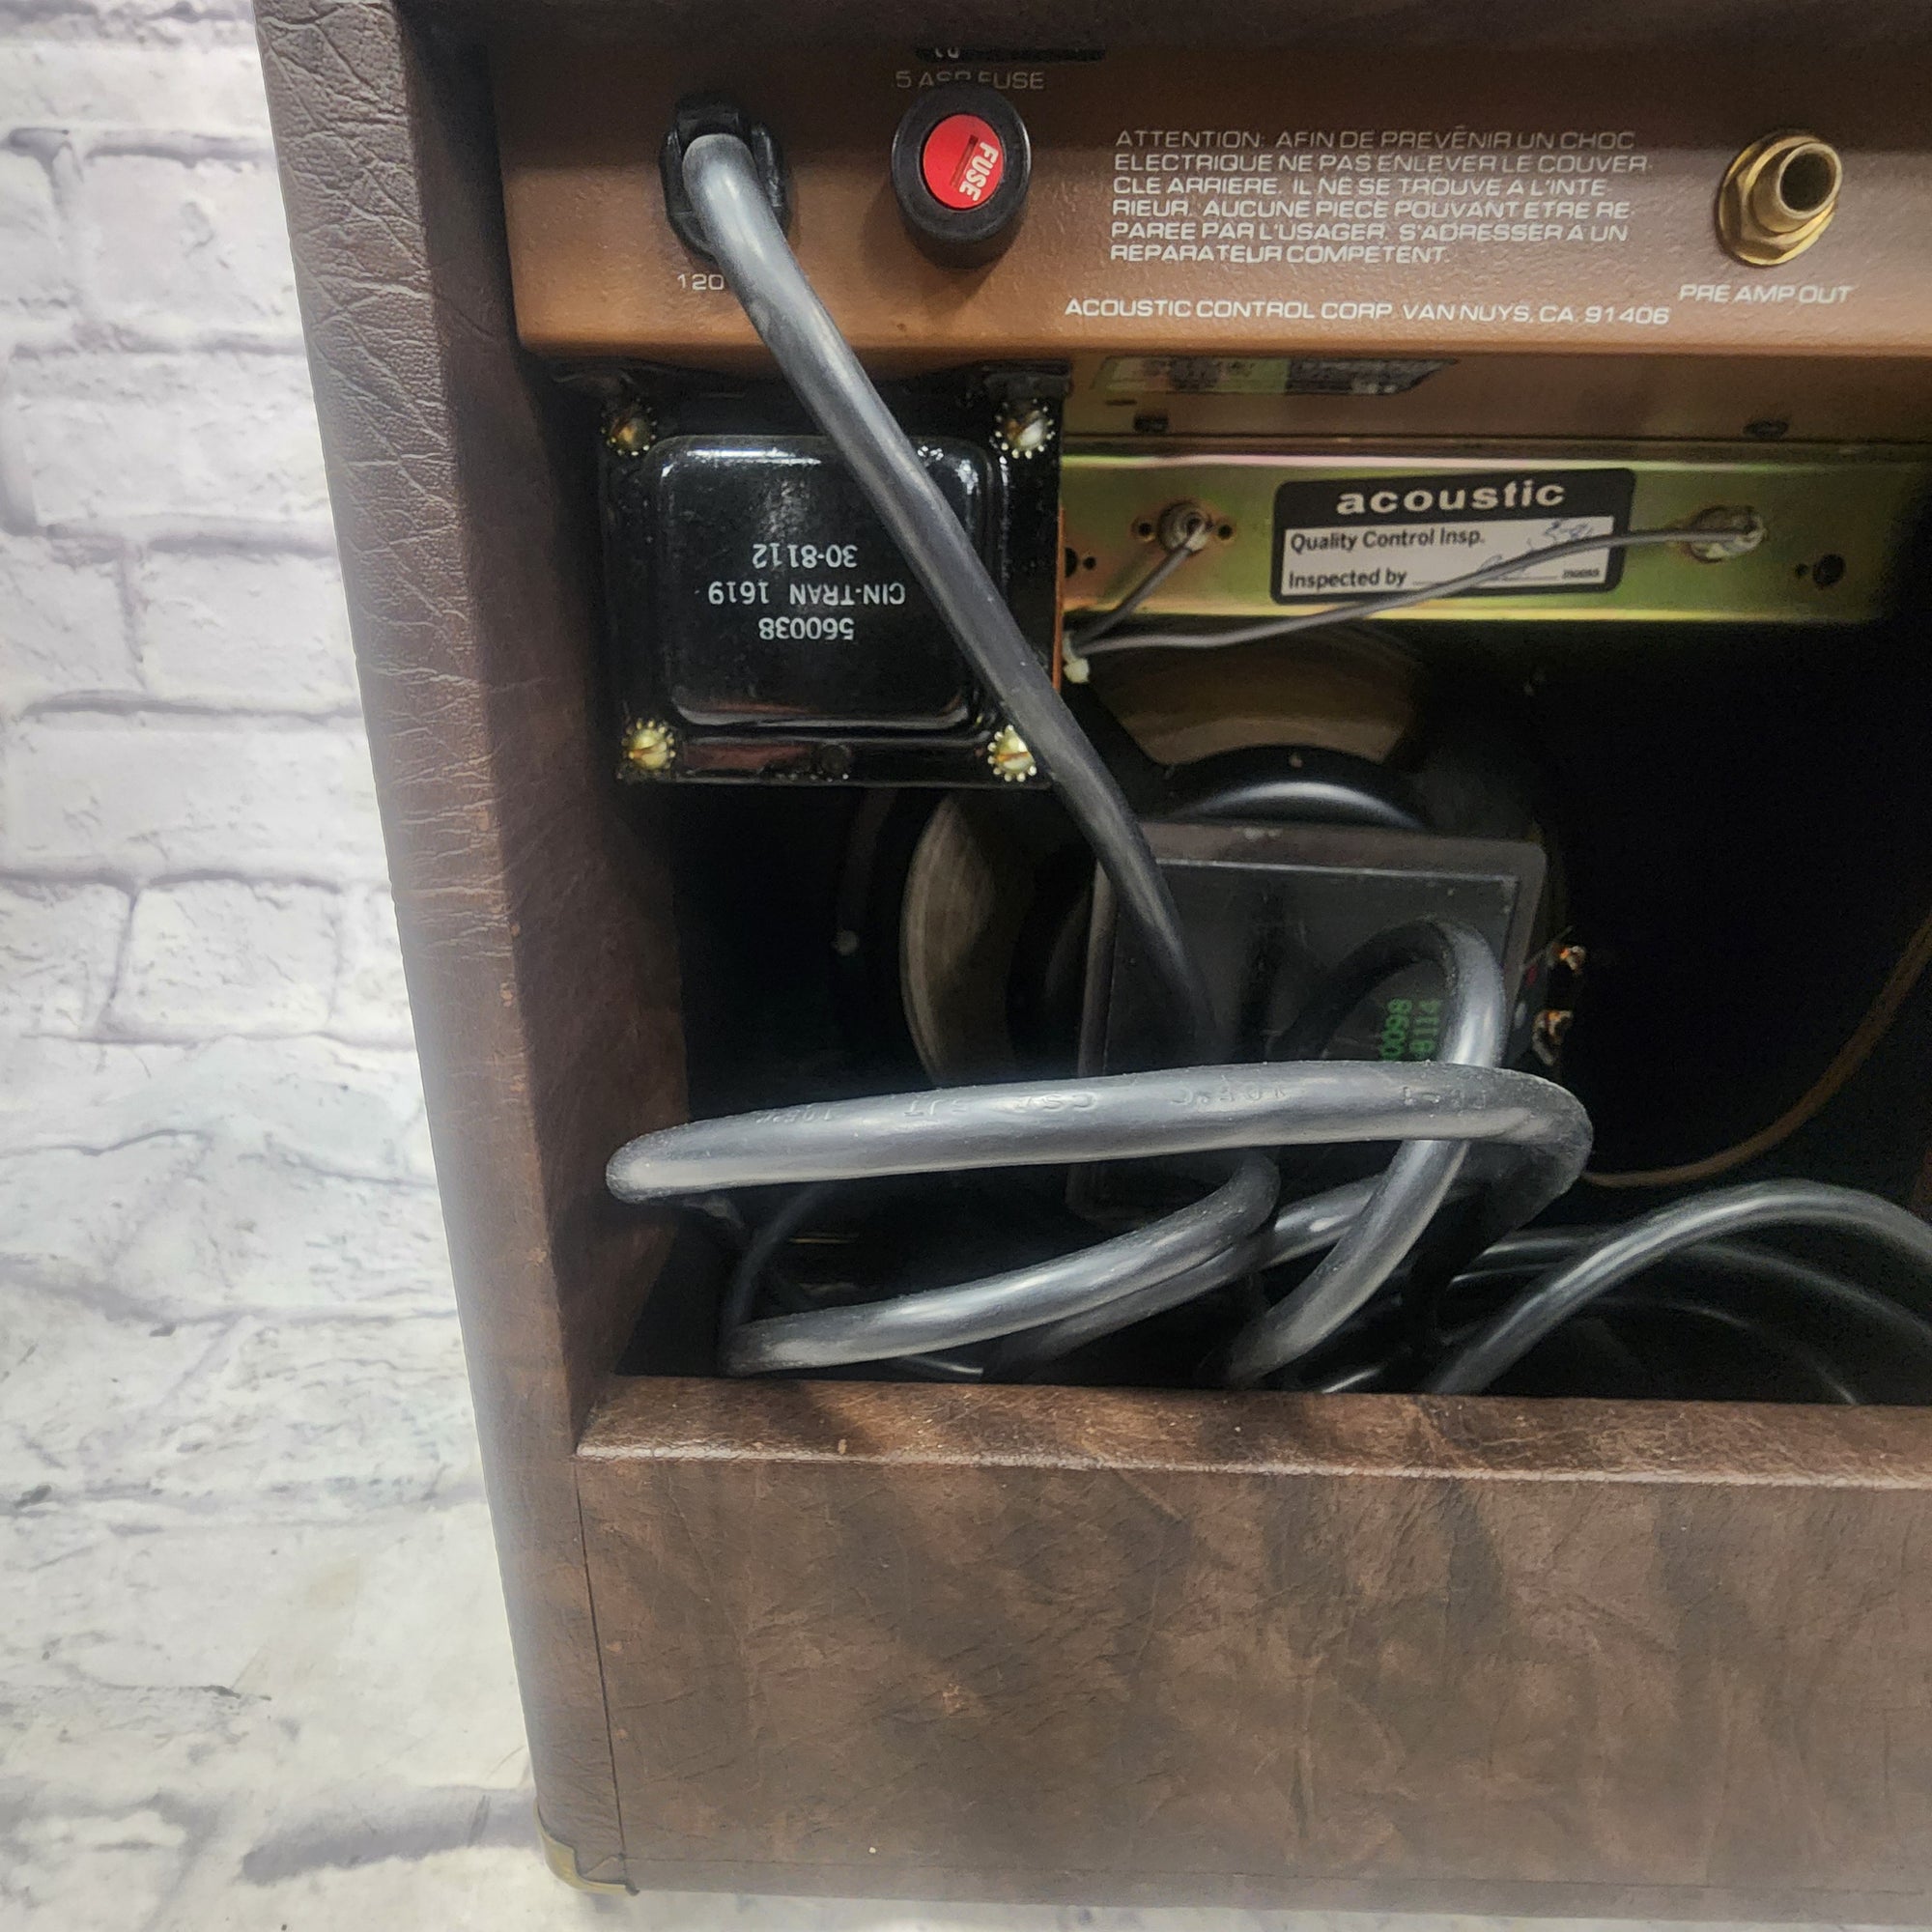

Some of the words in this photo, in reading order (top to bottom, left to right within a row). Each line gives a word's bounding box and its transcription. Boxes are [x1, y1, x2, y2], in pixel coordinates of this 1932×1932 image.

[895, 71, 912, 89] 5
[1276, 130, 1334, 149] AFIN
[1340, 130, 1375, 149] DE
[1517, 131, 1555, 150] UN
[1560, 131, 1636, 150] CHOC
[958, 141, 999, 202] FUSE
[1115, 154, 1273, 172] ELECTRIQUE
[1279, 155, 1313, 172] NE
[1319, 155, 1371, 172] PAS
[1378, 155, 1496, 173] ENLEVER
[1501, 156, 1533, 173] LE
[1113, 177, 1161, 194] CLE
[1293, 178, 1312, 195] IL
[1318, 178, 1353, 195] NE
[1357, 178, 1391, 195] SE
[1398, 178, 1503, 196] TROUVE
[1506, 179, 1524, 195] A
[1203, 200, 1311, 218] AUCUNE
[1316, 200, 1389, 218] PIECE
[1394, 200, 1520, 218] POUVANT
[1523, 201, 1591, 219] ETRE
[1111, 221, 1197, 240] PAREE
[1202, 222, 1255, 241] PAR
[1399, 223, 1563, 242] S'ADRESSER
[1566, 224, 1584, 242] A
[1590, 224, 1629, 242] UN
[1110, 244, 1283, 263] REPARATEUR
[676, 273, 724, 291] 120
[1678, 283, 1731, 302] PRE
[1733, 284, 1796, 302] AMP
[1799, 284, 1856, 304] OUT
[1065, 298, 1191, 318] ACOUSTIC
[1196, 299, 1316, 319] CONTROL
[1403, 303, 1455, 322] VAN
[1584, 304, 1670, 325] 91406
[1336, 480, 1565, 515] acoustic
[1290, 532, 1358, 554] Quality
[1362, 528, 1435, 549] Control
[1439, 526, 1487, 548] Insp.
[752, 542, 859, 569] 30-8112
[1289, 568, 1381, 590] Inspected
[1384, 566, 1407, 586] by
[707, 580, 770, 605] 1619
[789, 582, 906, 606] CIN-TRAN
[757, 615, 855, 640] 560038
